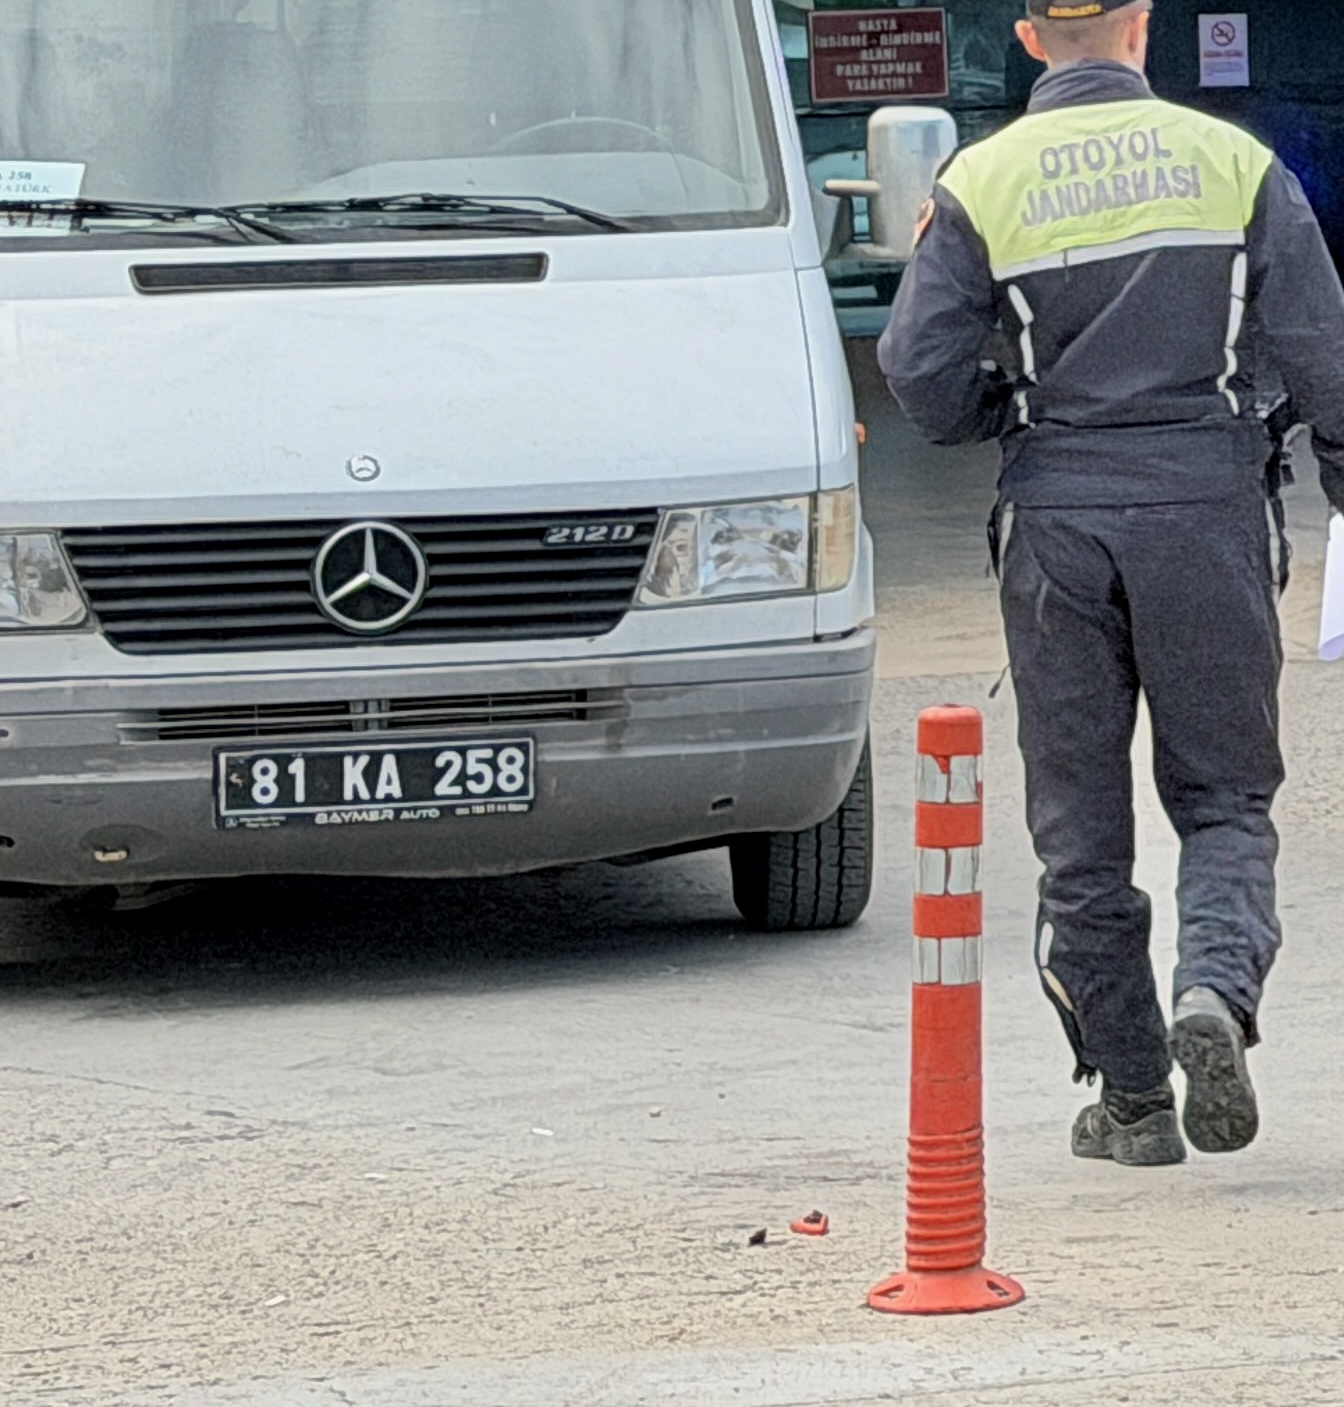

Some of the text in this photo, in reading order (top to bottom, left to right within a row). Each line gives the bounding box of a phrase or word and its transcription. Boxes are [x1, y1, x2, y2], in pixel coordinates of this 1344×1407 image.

[1040, 127, 1172, 180] OTOYOL
[1021, 164, 1202, 227] JANDARMASI
[252, 747, 525, 804] 81 KA 258
[400, 807, 441, 820] AUTO
